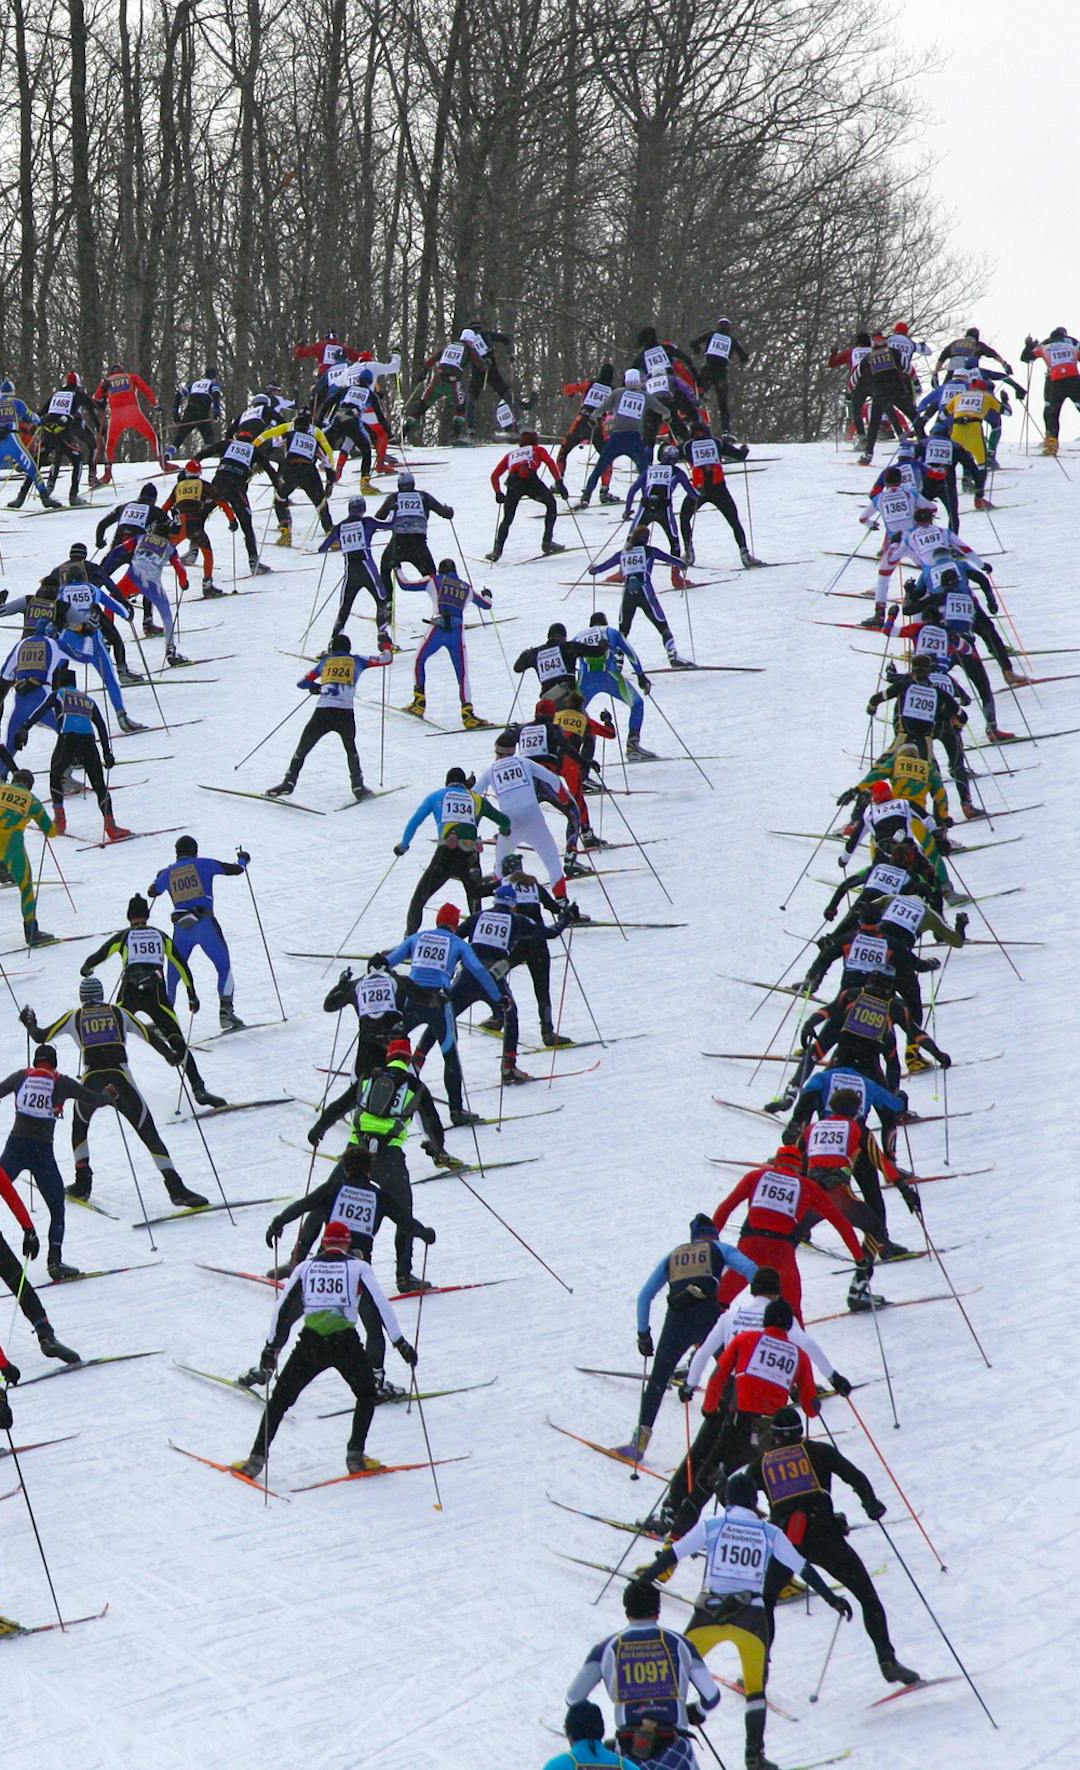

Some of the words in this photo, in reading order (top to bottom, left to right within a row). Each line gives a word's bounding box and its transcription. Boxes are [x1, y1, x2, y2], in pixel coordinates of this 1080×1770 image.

[496, 768, 522, 782] 1470
[0, 792, 27, 807] 1822
[172, 876, 197, 891] 1005
[873, 871, 899, 887] 1363
[892, 906, 919, 923] 1314
[417, 947, 446, 961] 1628
[853, 947, 882, 964] 1666
[361, 988, 390, 1003] 1282
[83, 1018, 115, 1032] 1077
[854, 1007, 884, 1027] 1099
[760, 1183, 795, 1203] 1654
[338, 1203, 371, 1221] 1623
[674, 1250, 707, 1266] 1016
[309, 1277, 343, 1294] 1336
[759, 1349, 794, 1372] 1540
[767, 1460, 809, 1482] 1130
[720, 1544, 761, 1567] 1500
[623, 1661, 668, 1684] 1097
